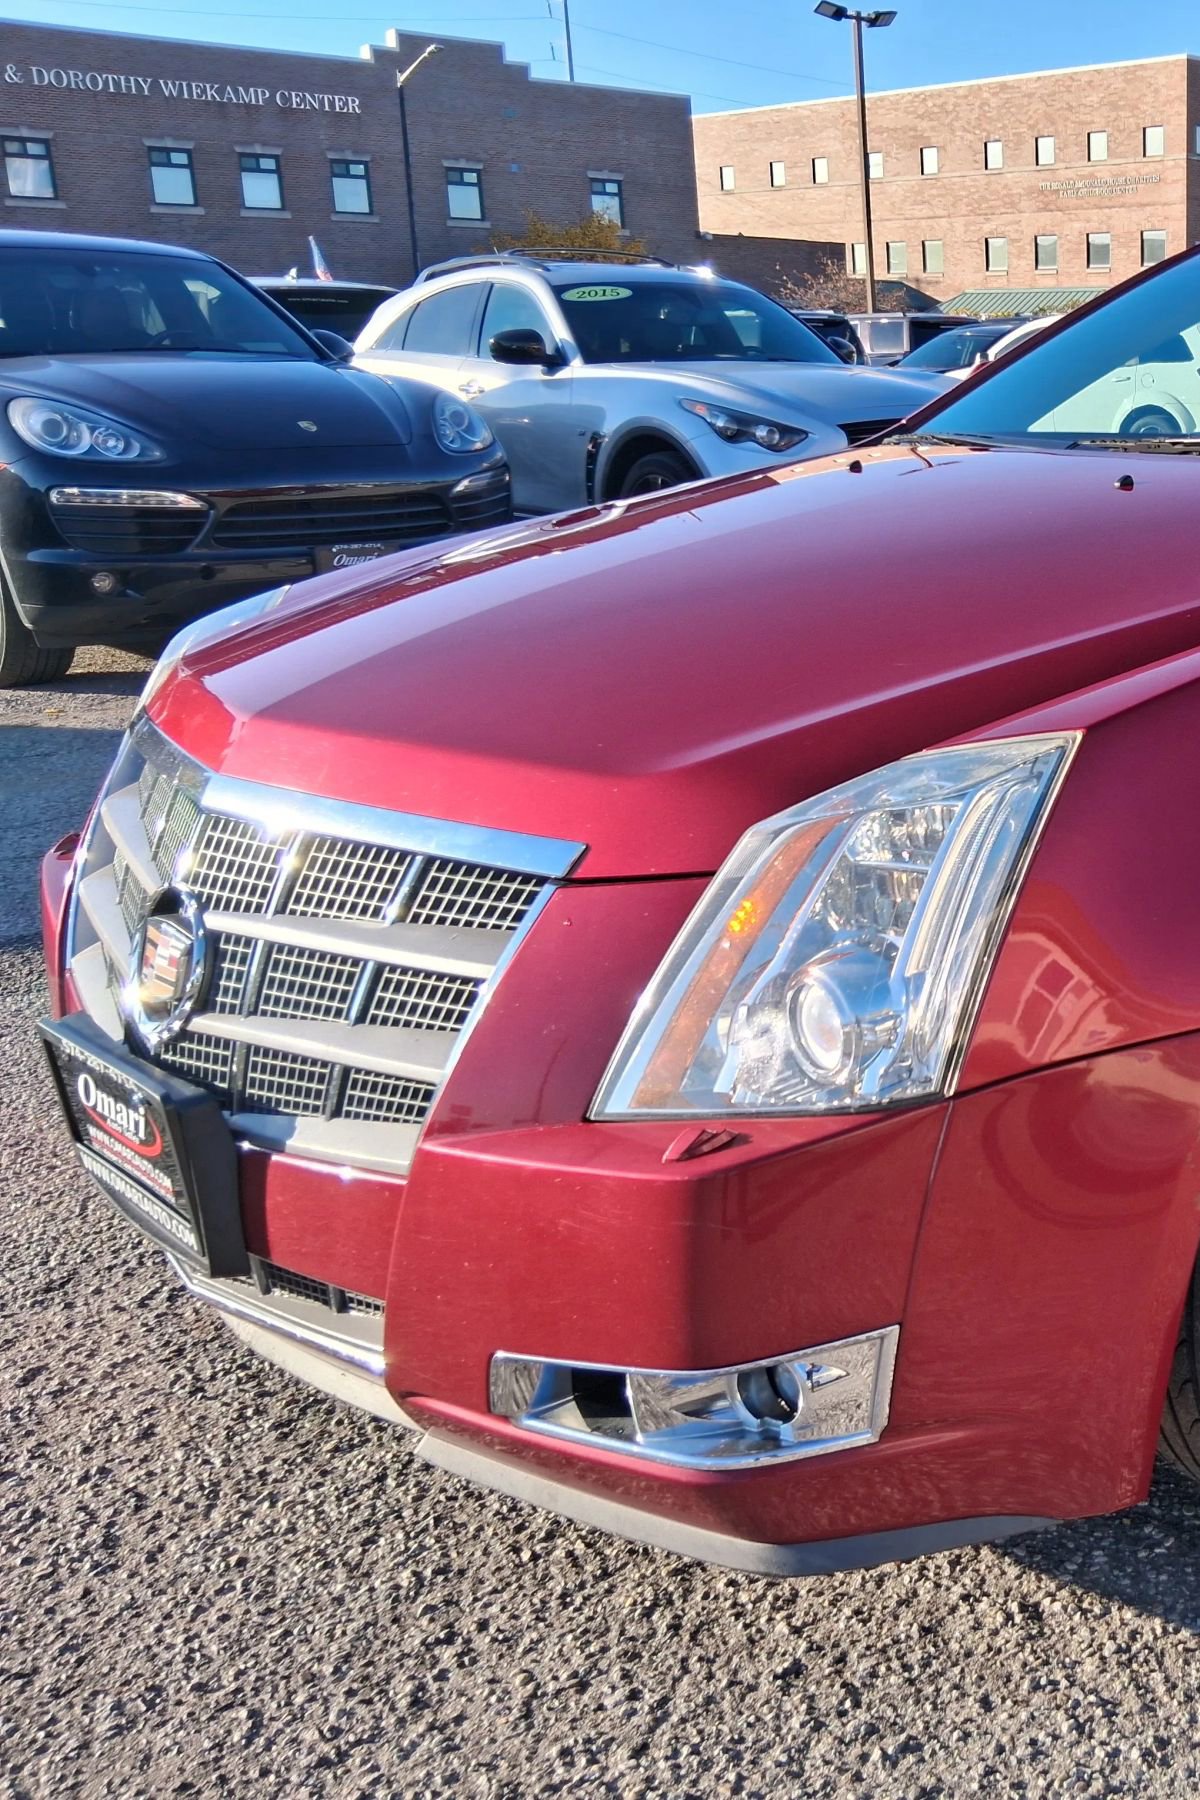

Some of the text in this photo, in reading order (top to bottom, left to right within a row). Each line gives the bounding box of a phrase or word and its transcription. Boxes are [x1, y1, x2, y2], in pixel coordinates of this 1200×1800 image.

[4, 63, 362, 114] & DOROTHY WIEKAMP CENTER
[576, 288, 620, 299] 2015
[78, 1073, 147, 1142] Omari
